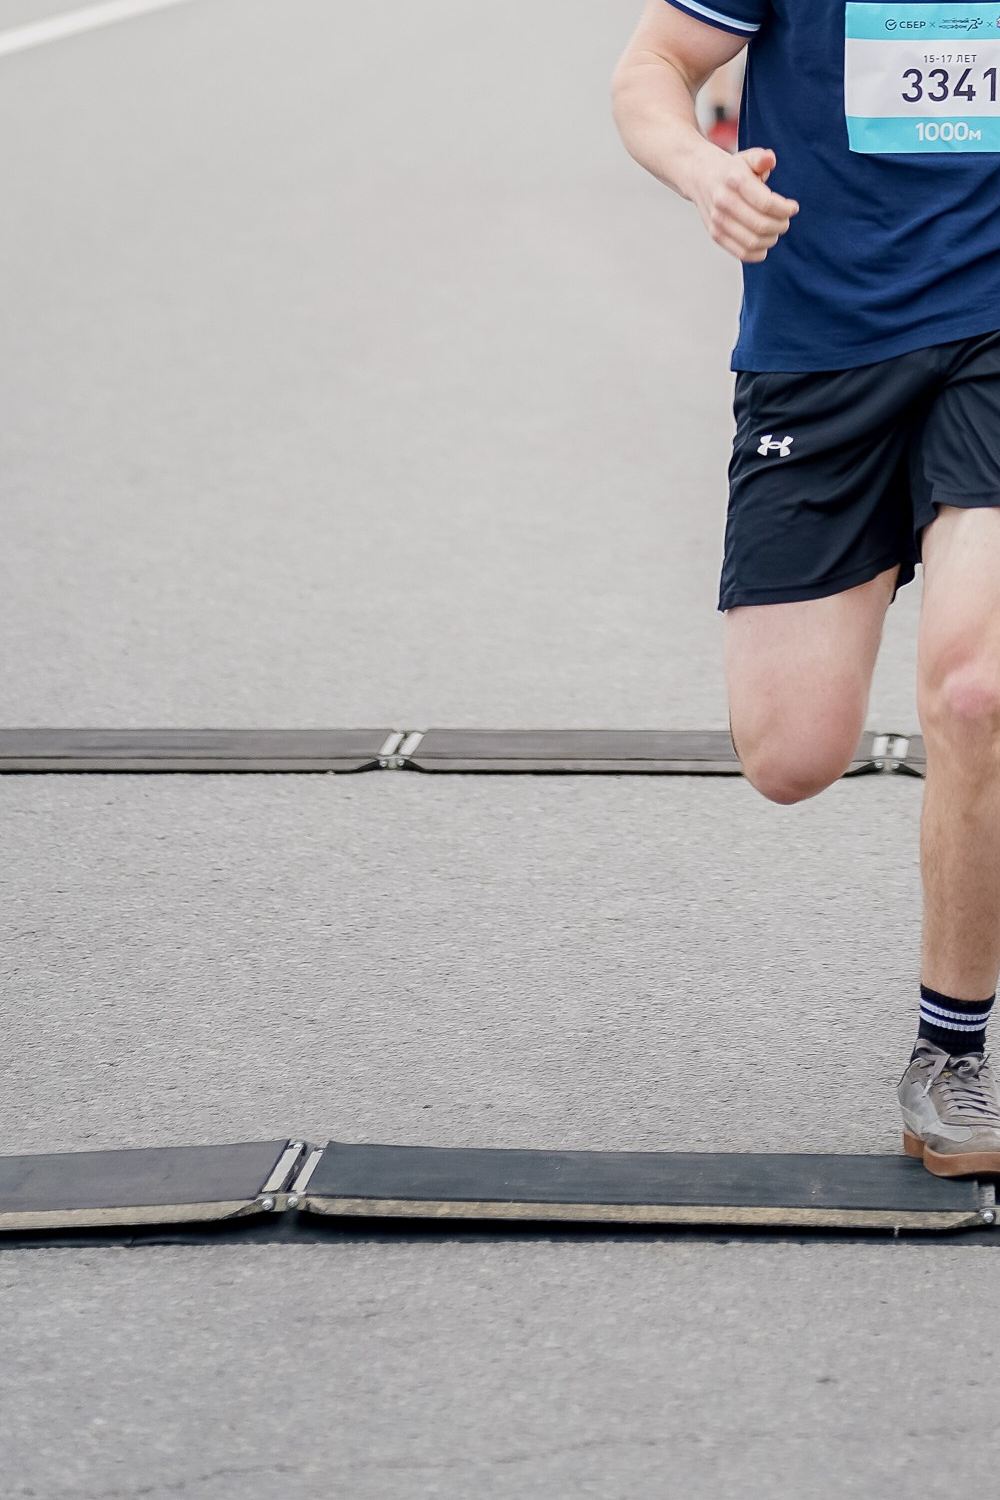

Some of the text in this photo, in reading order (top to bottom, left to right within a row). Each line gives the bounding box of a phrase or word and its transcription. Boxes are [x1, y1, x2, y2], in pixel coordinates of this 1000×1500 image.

[899, 21, 926, 29] СБЕР
[923, 54, 977, 63] 15-17 ЛЕТ
[901, 67, 997, 103] 3341
